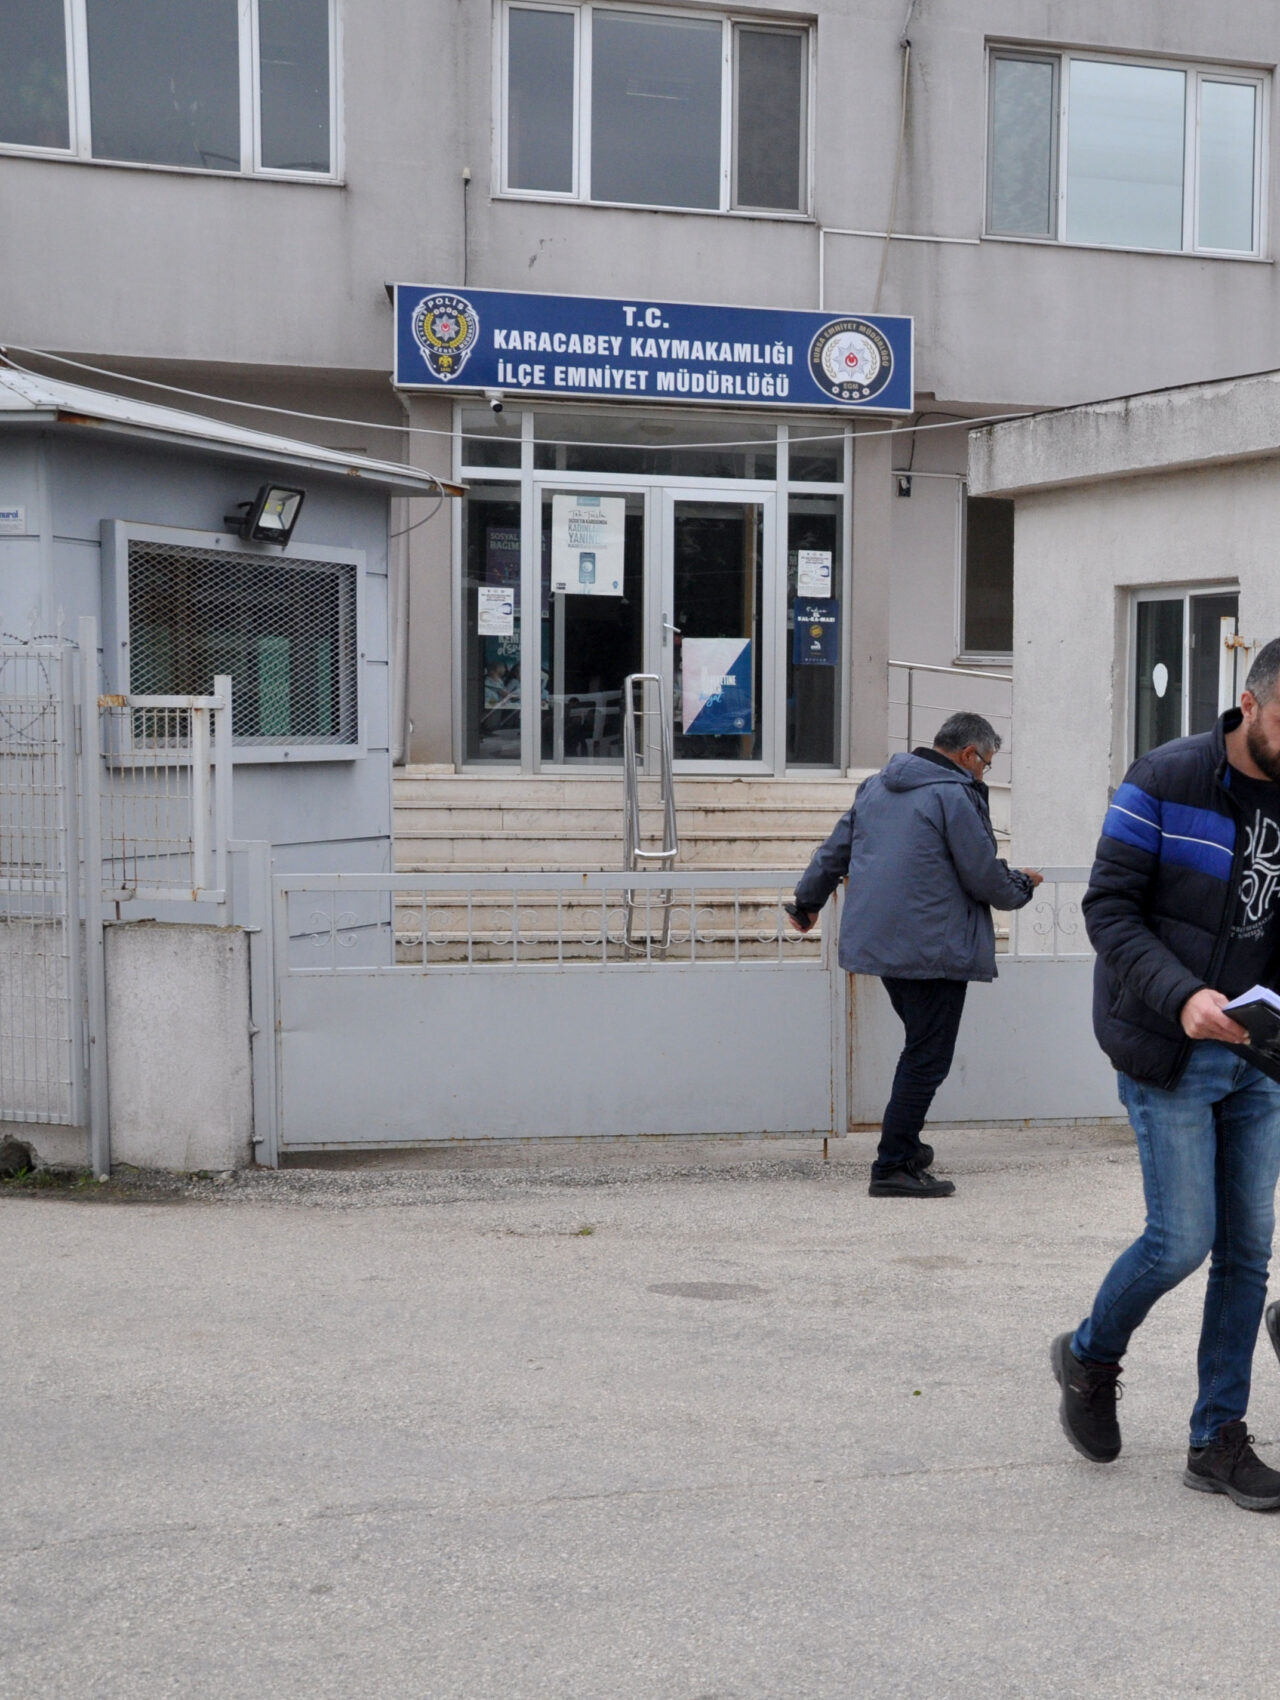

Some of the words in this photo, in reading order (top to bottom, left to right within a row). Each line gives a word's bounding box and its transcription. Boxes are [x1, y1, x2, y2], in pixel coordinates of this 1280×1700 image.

[622, 305, 670, 329] T.C.
[494, 328, 622, 356] KARACABEY
[630, 336, 793, 365] KAYMAKAMLIĞI
[497, 358, 546, 387] İLÇE
[554, 364, 649, 390] EMNİYET
[656, 368, 789, 397] MÜDÜRLÜĞÜ
